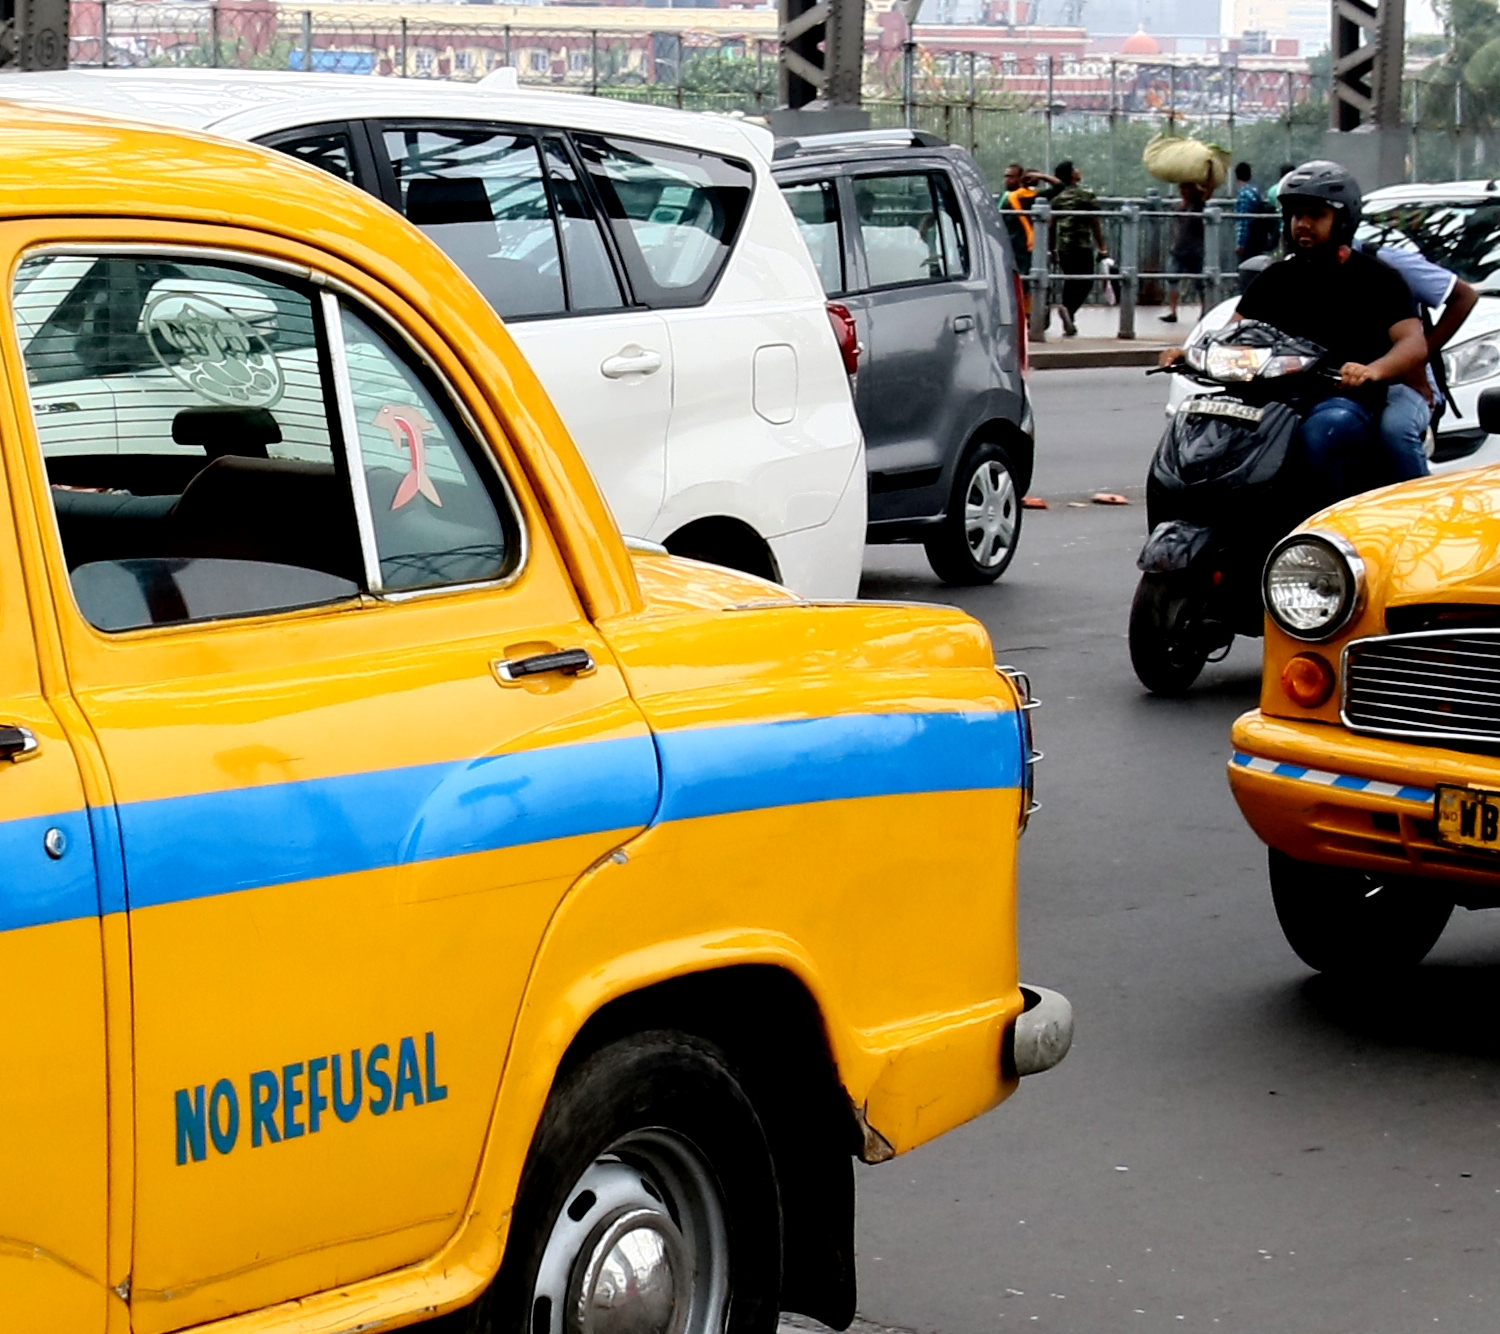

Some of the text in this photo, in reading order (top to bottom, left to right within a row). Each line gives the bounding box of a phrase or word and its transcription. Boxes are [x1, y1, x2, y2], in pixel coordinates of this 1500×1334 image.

[1460, 799, 1500, 842] WB
[174, 1030, 448, 1166] NO REFUSAL
